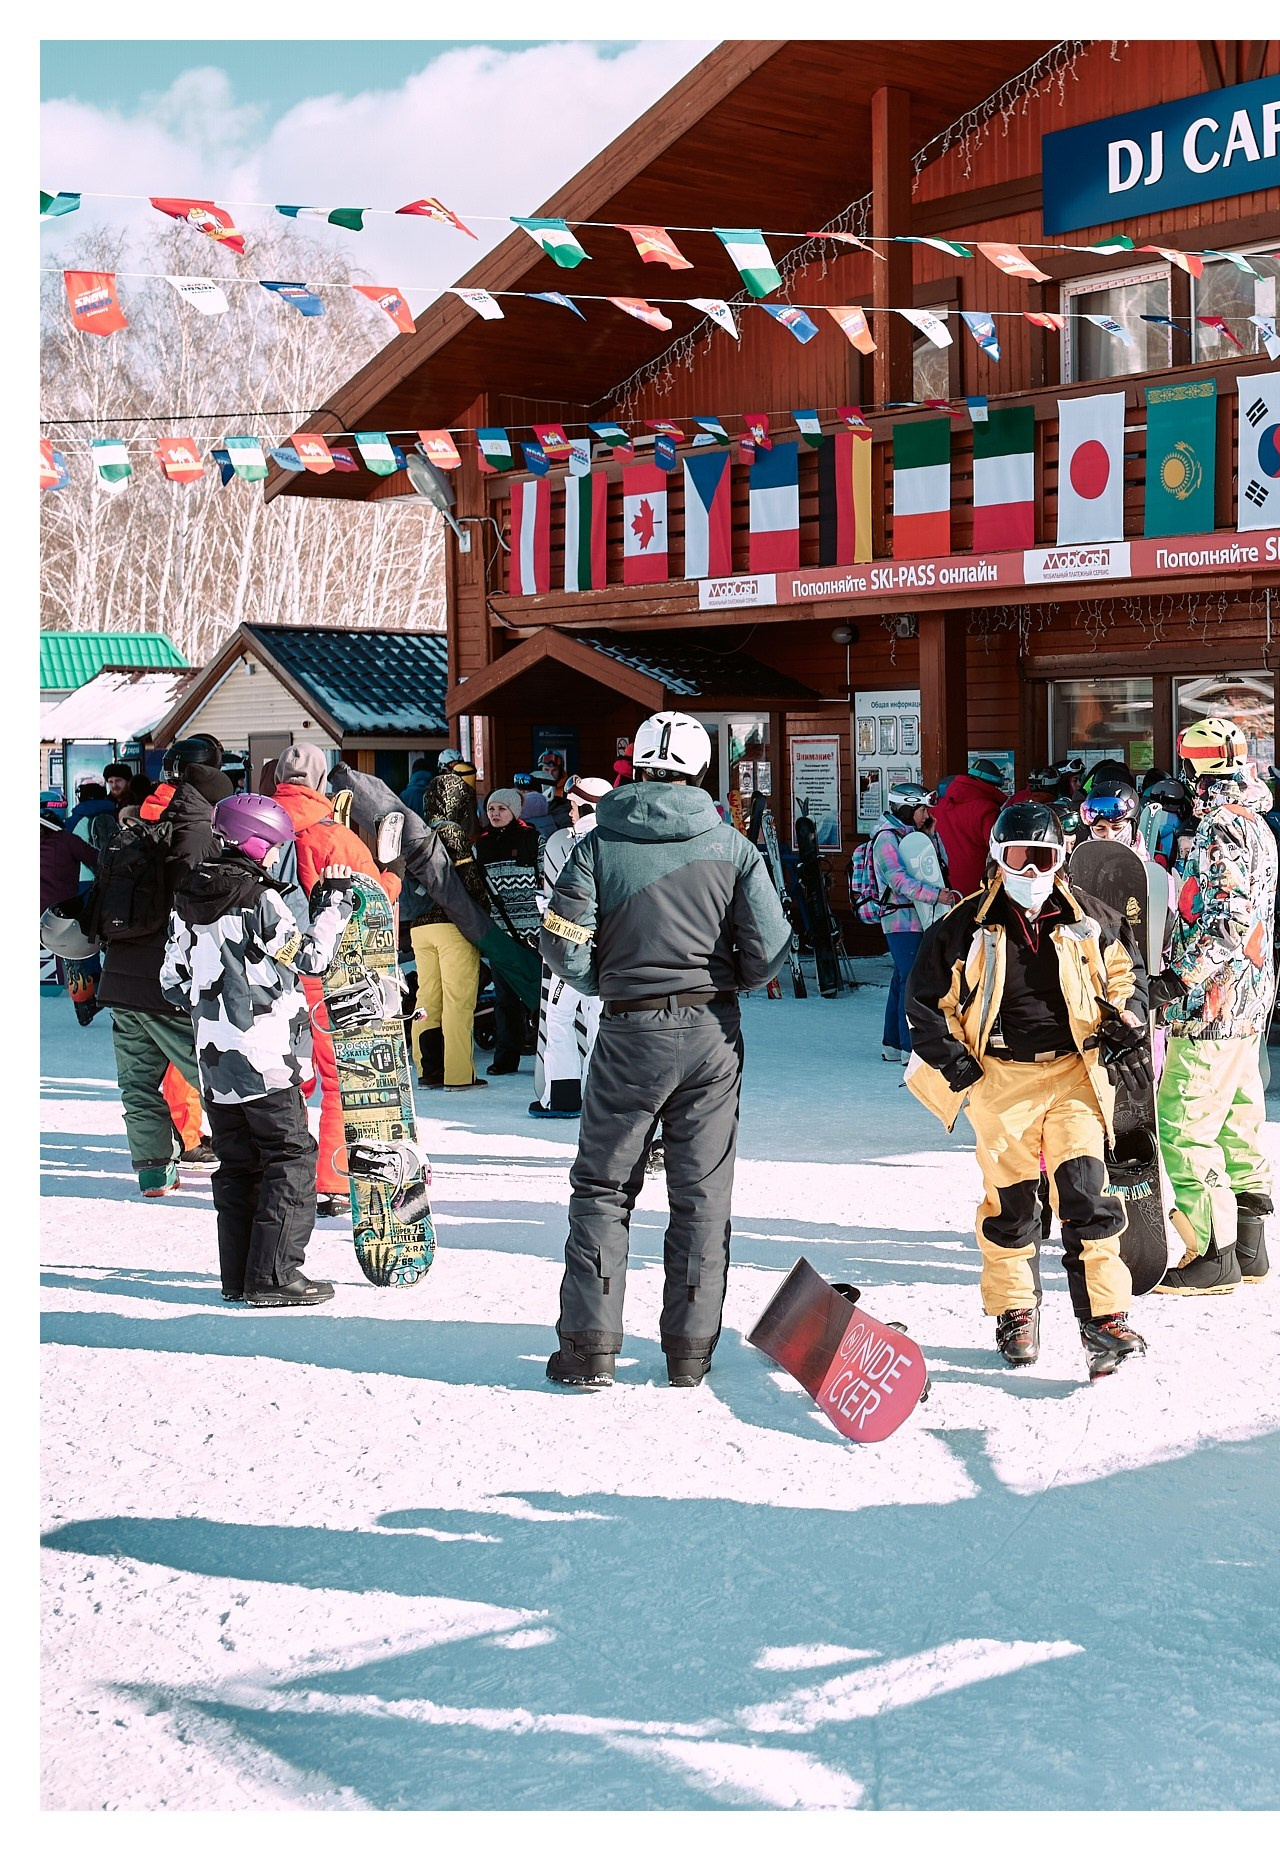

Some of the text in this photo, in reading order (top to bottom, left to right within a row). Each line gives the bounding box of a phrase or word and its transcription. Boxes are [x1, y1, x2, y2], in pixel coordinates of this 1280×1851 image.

[1107, 130, 1164, 194] DJ
[1043, 549, 1110, 570] MobiCash
[1156, 546, 1259, 569] Пополняйте
[709, 580, 759, 597] MobiCash
[792, 563, 998, 598] Пополняйте SKI-PASS онлайн
[870, 701, 889, 709] Общая
[796, 752, 834, 761] Внимание!
[335, 1040, 387, 1057] ROCKET
[344, 1049, 370, 1057] SKATES
[344, 1091, 390, 1105] NITRO
[405, 1244, 430, 1253] X-RAY
